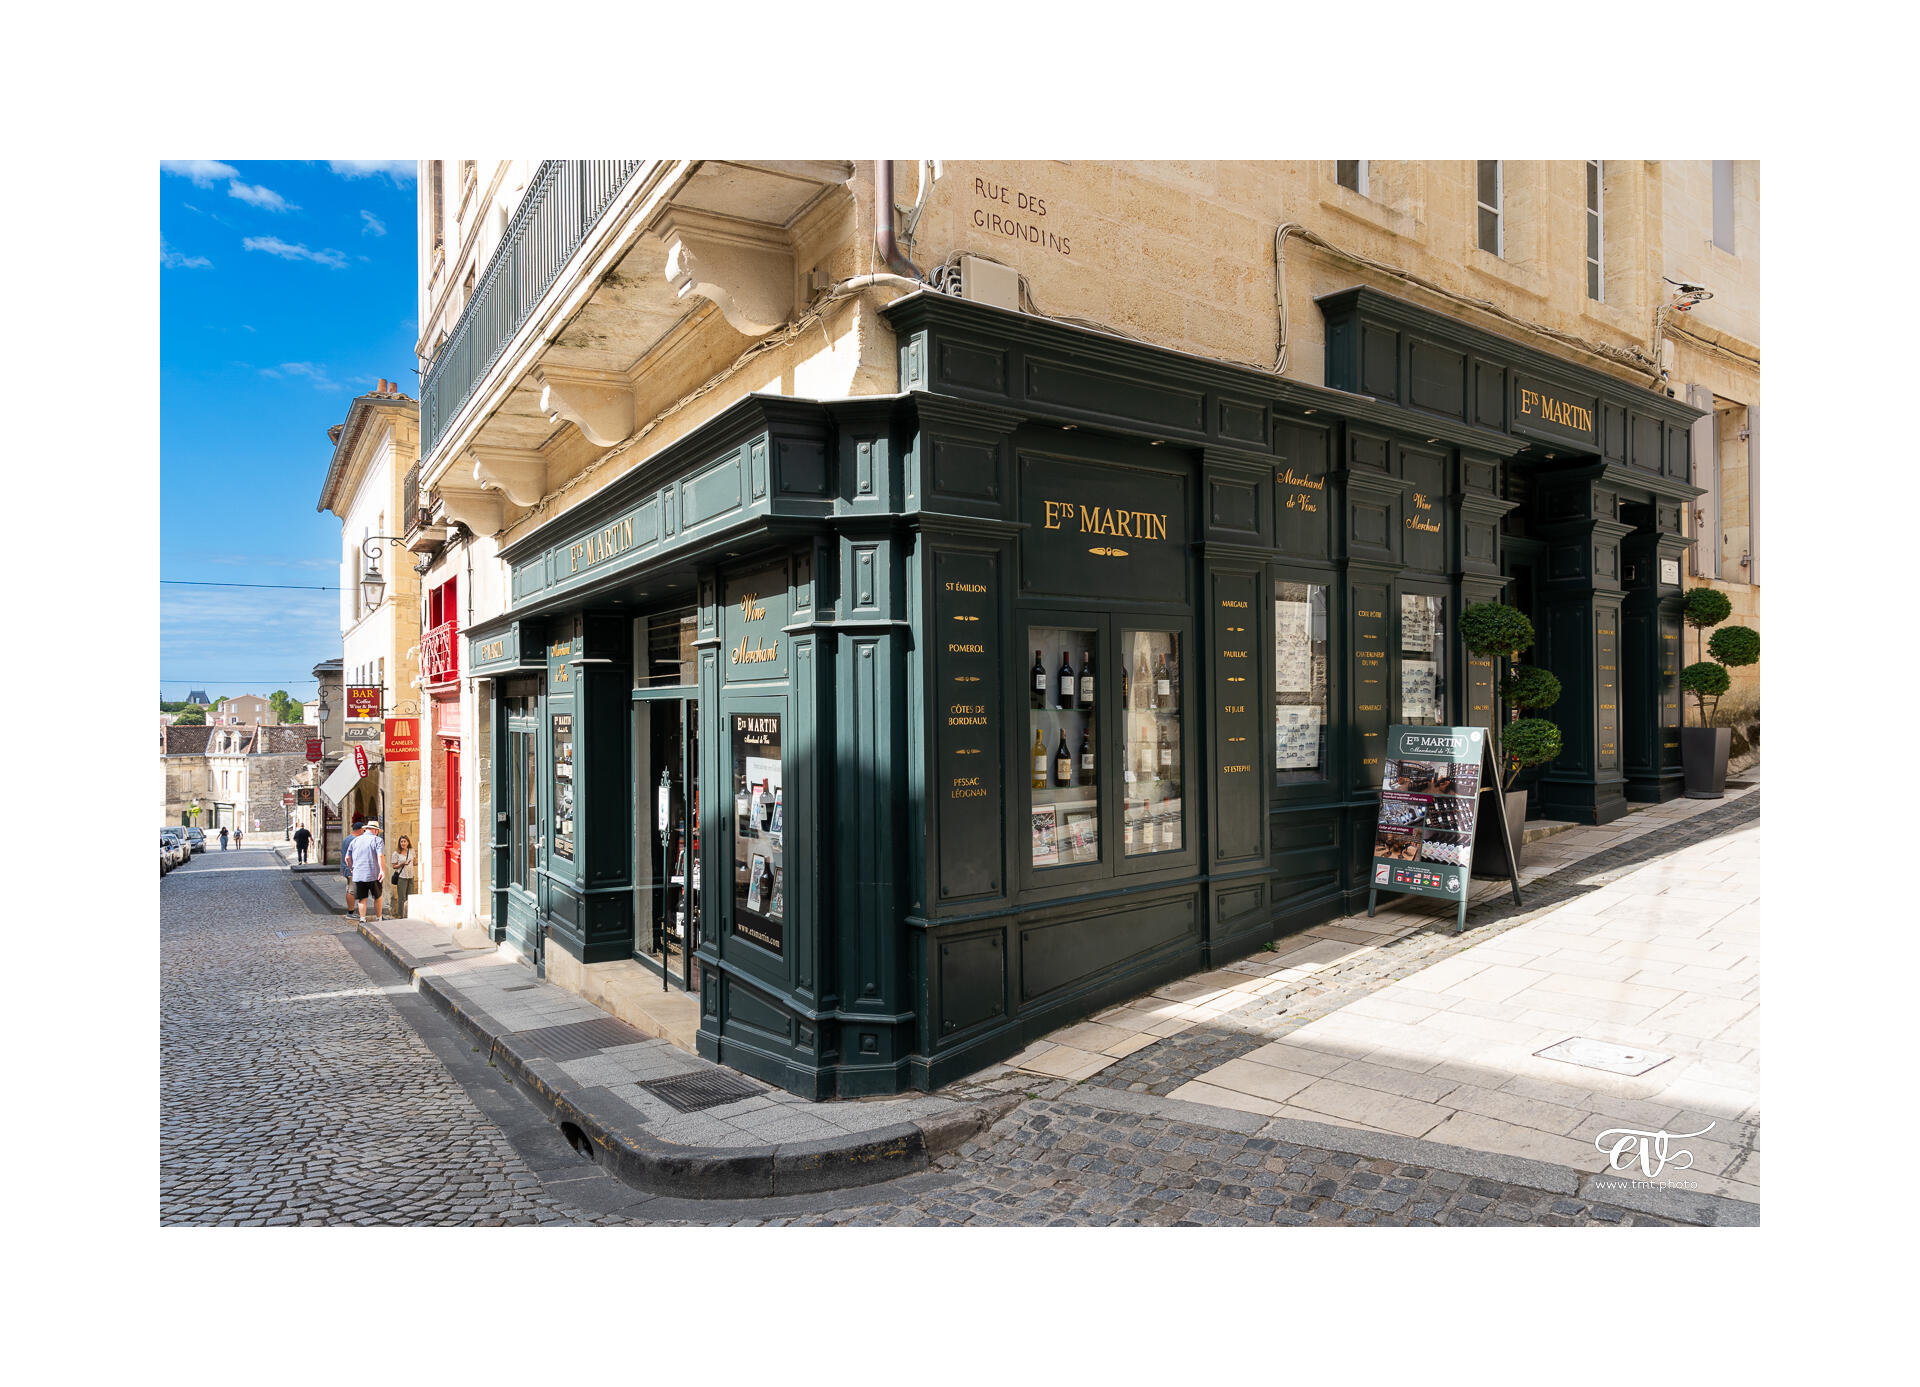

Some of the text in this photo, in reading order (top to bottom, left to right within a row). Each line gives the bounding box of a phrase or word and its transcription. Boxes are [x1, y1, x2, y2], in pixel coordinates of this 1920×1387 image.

[974, 177, 1047, 216] RUE DES
[973, 209, 1072, 256] GIRONDINS
[1541, 395, 1593, 433] MARTIN
[1276, 467, 1325, 491] Marchand
[1286, 493, 1317, 513] de Vins
[1413, 492, 1431, 510] Wine
[1079, 504, 1167, 541] MARTIN
[1405, 514, 1441, 533] Merchant
[586, 517, 633, 566] MARTIN
[945, 580, 987, 594] ST ÉMILION
[740, 593, 766, 622] Wine
[1222, 600, 1248, 608] MARGAUX
[731, 636, 779, 666] Merchant
[948, 643, 985, 654] POMEROL
[352, 689, 374, 698] BAR
[950, 703, 985, 715] CÔTES DE
[747, 717, 778, 733] MARTIN
[948, 716, 988, 726] BORDEAUX
[1421, 736, 1462, 748] MARTIN
[355, 746, 368, 777] TABAC
[953, 776, 980, 787] PESSAC
[951, 788, 987, 799] LÉOGNAN
